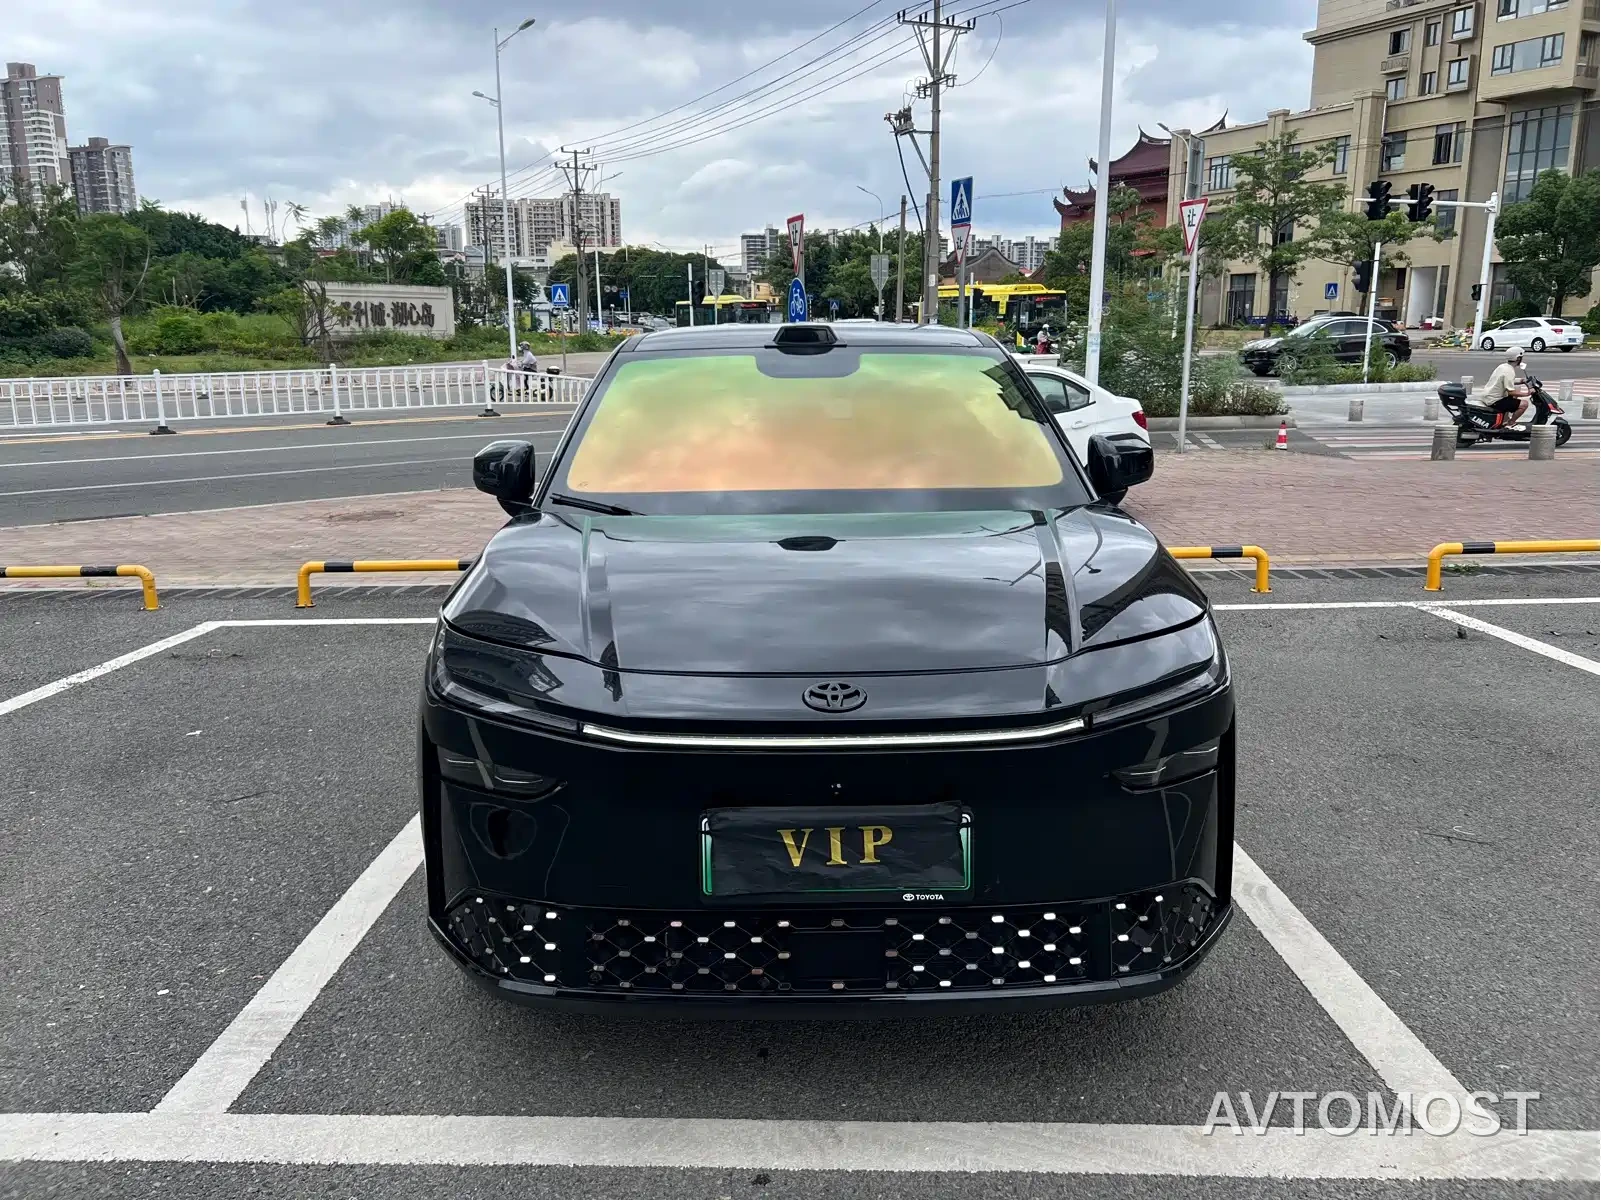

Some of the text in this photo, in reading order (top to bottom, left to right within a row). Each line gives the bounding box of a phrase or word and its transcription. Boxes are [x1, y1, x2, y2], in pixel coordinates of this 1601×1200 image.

[1187, 208, 1196, 227] 让
[792, 223, 798, 246] 让
[1471, 415, 1490, 428] LIMA
[776, 824, 893, 868] VIP
